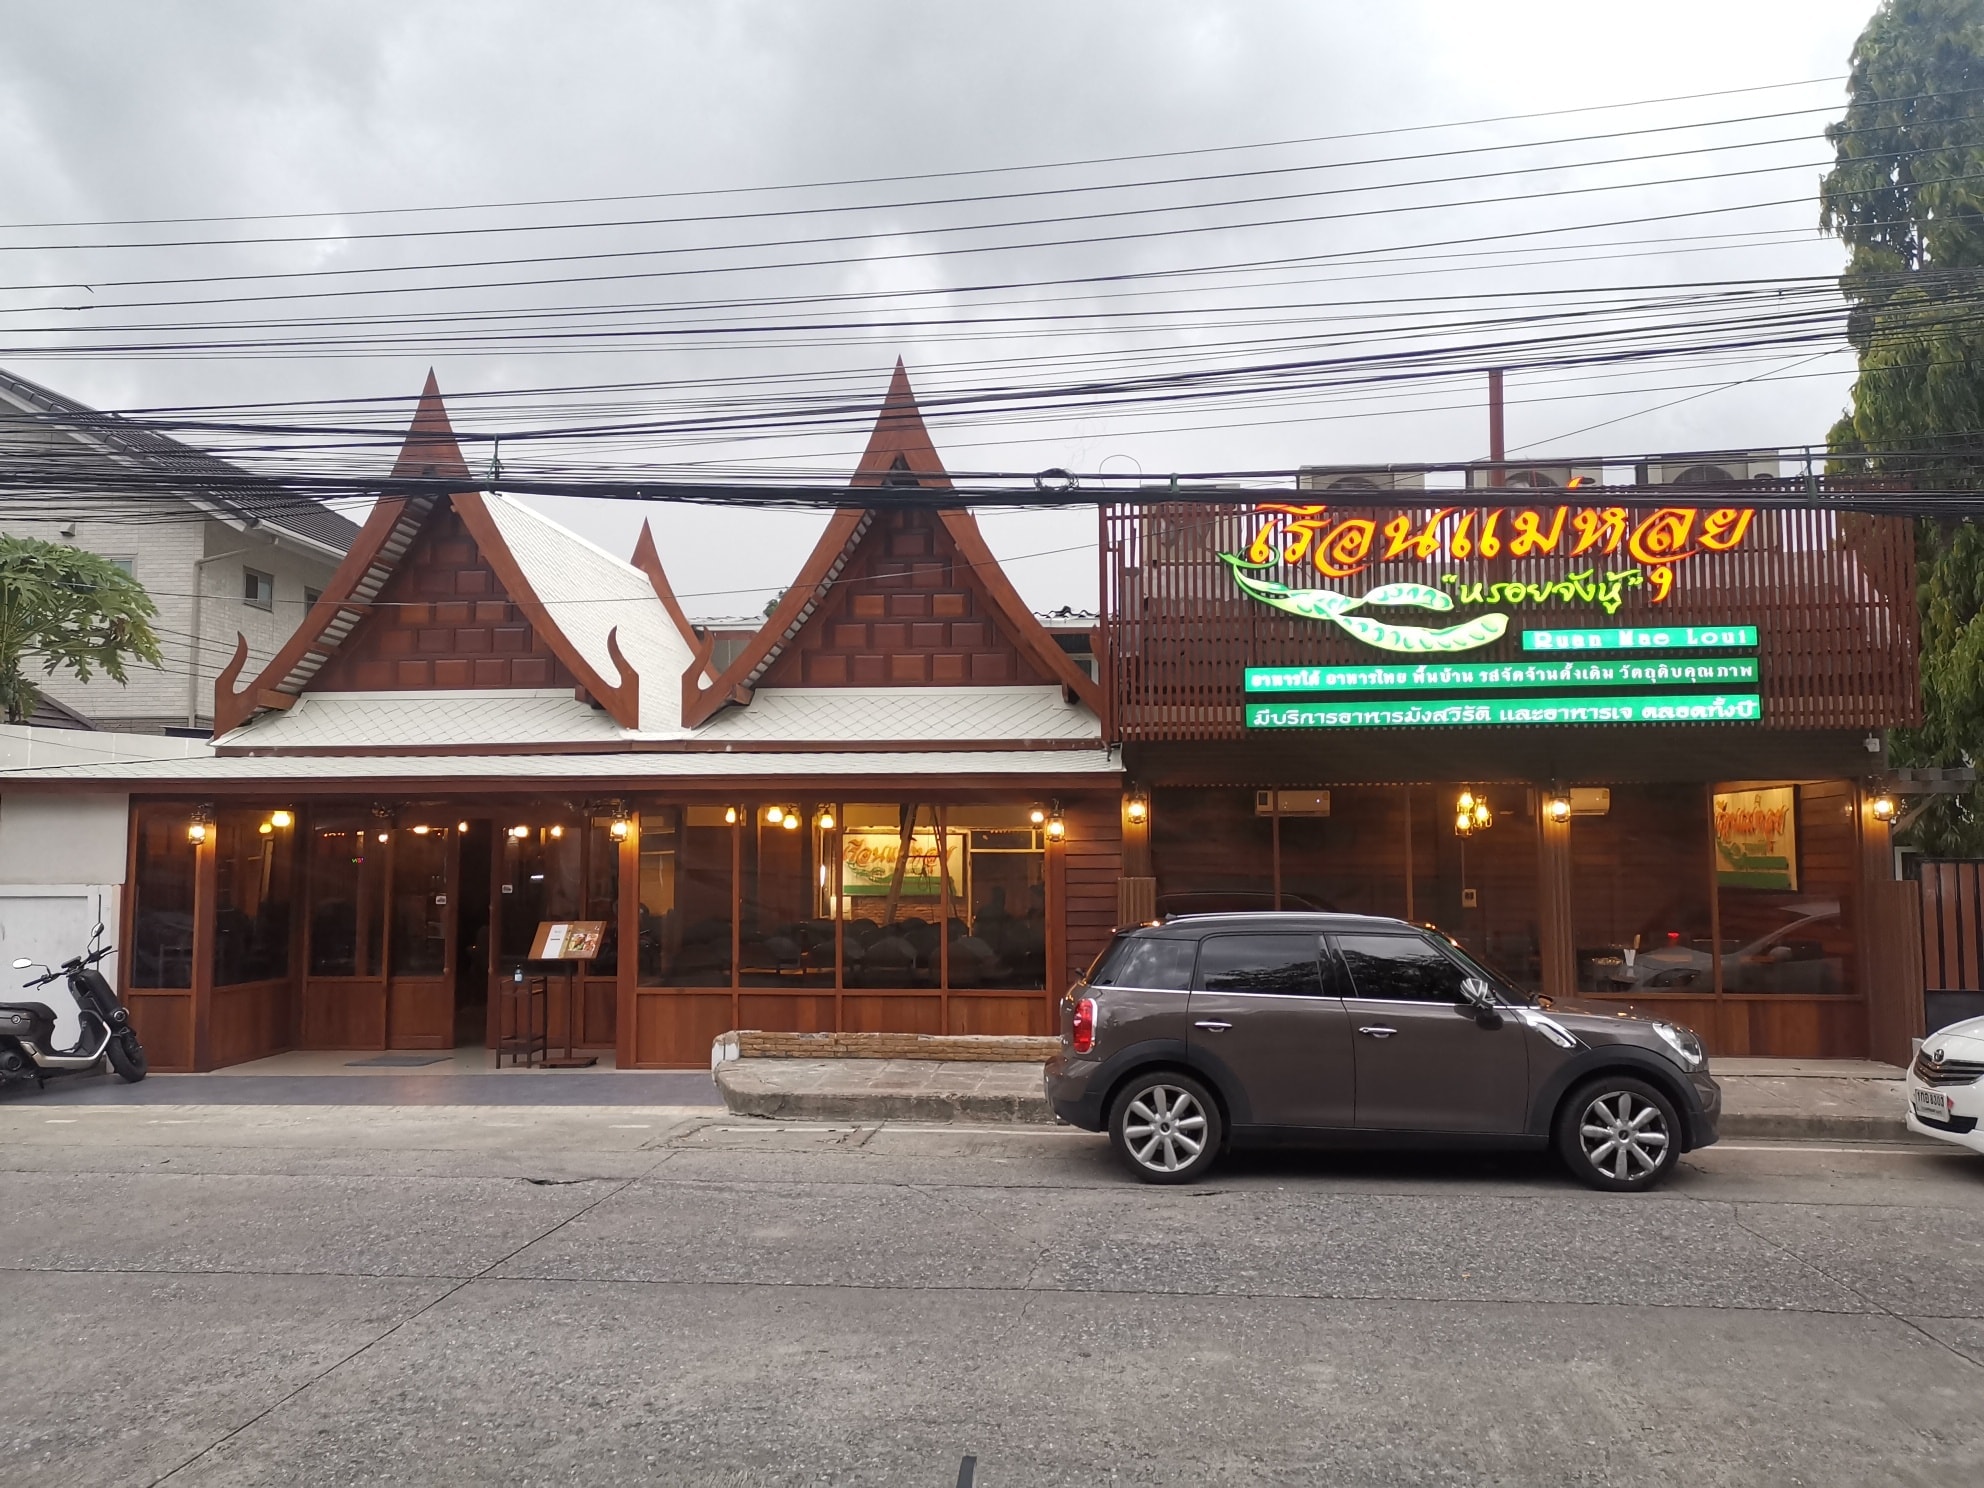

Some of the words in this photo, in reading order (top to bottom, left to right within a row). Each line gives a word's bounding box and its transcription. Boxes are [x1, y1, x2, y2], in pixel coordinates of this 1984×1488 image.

[1533, 630, 1603, 649] Ruan
[1618, 628, 1671, 646] Mae
[1686, 627, 1747, 645] Loui
[1325, 669, 1406, 686] อาหารไทย
[1412, 664, 1474, 684] พื้นบ้าน
[1499, 703, 1633, 722] และอาหารเจ
[1641, 696, 1759, 720] ตลอดทั้งปี
